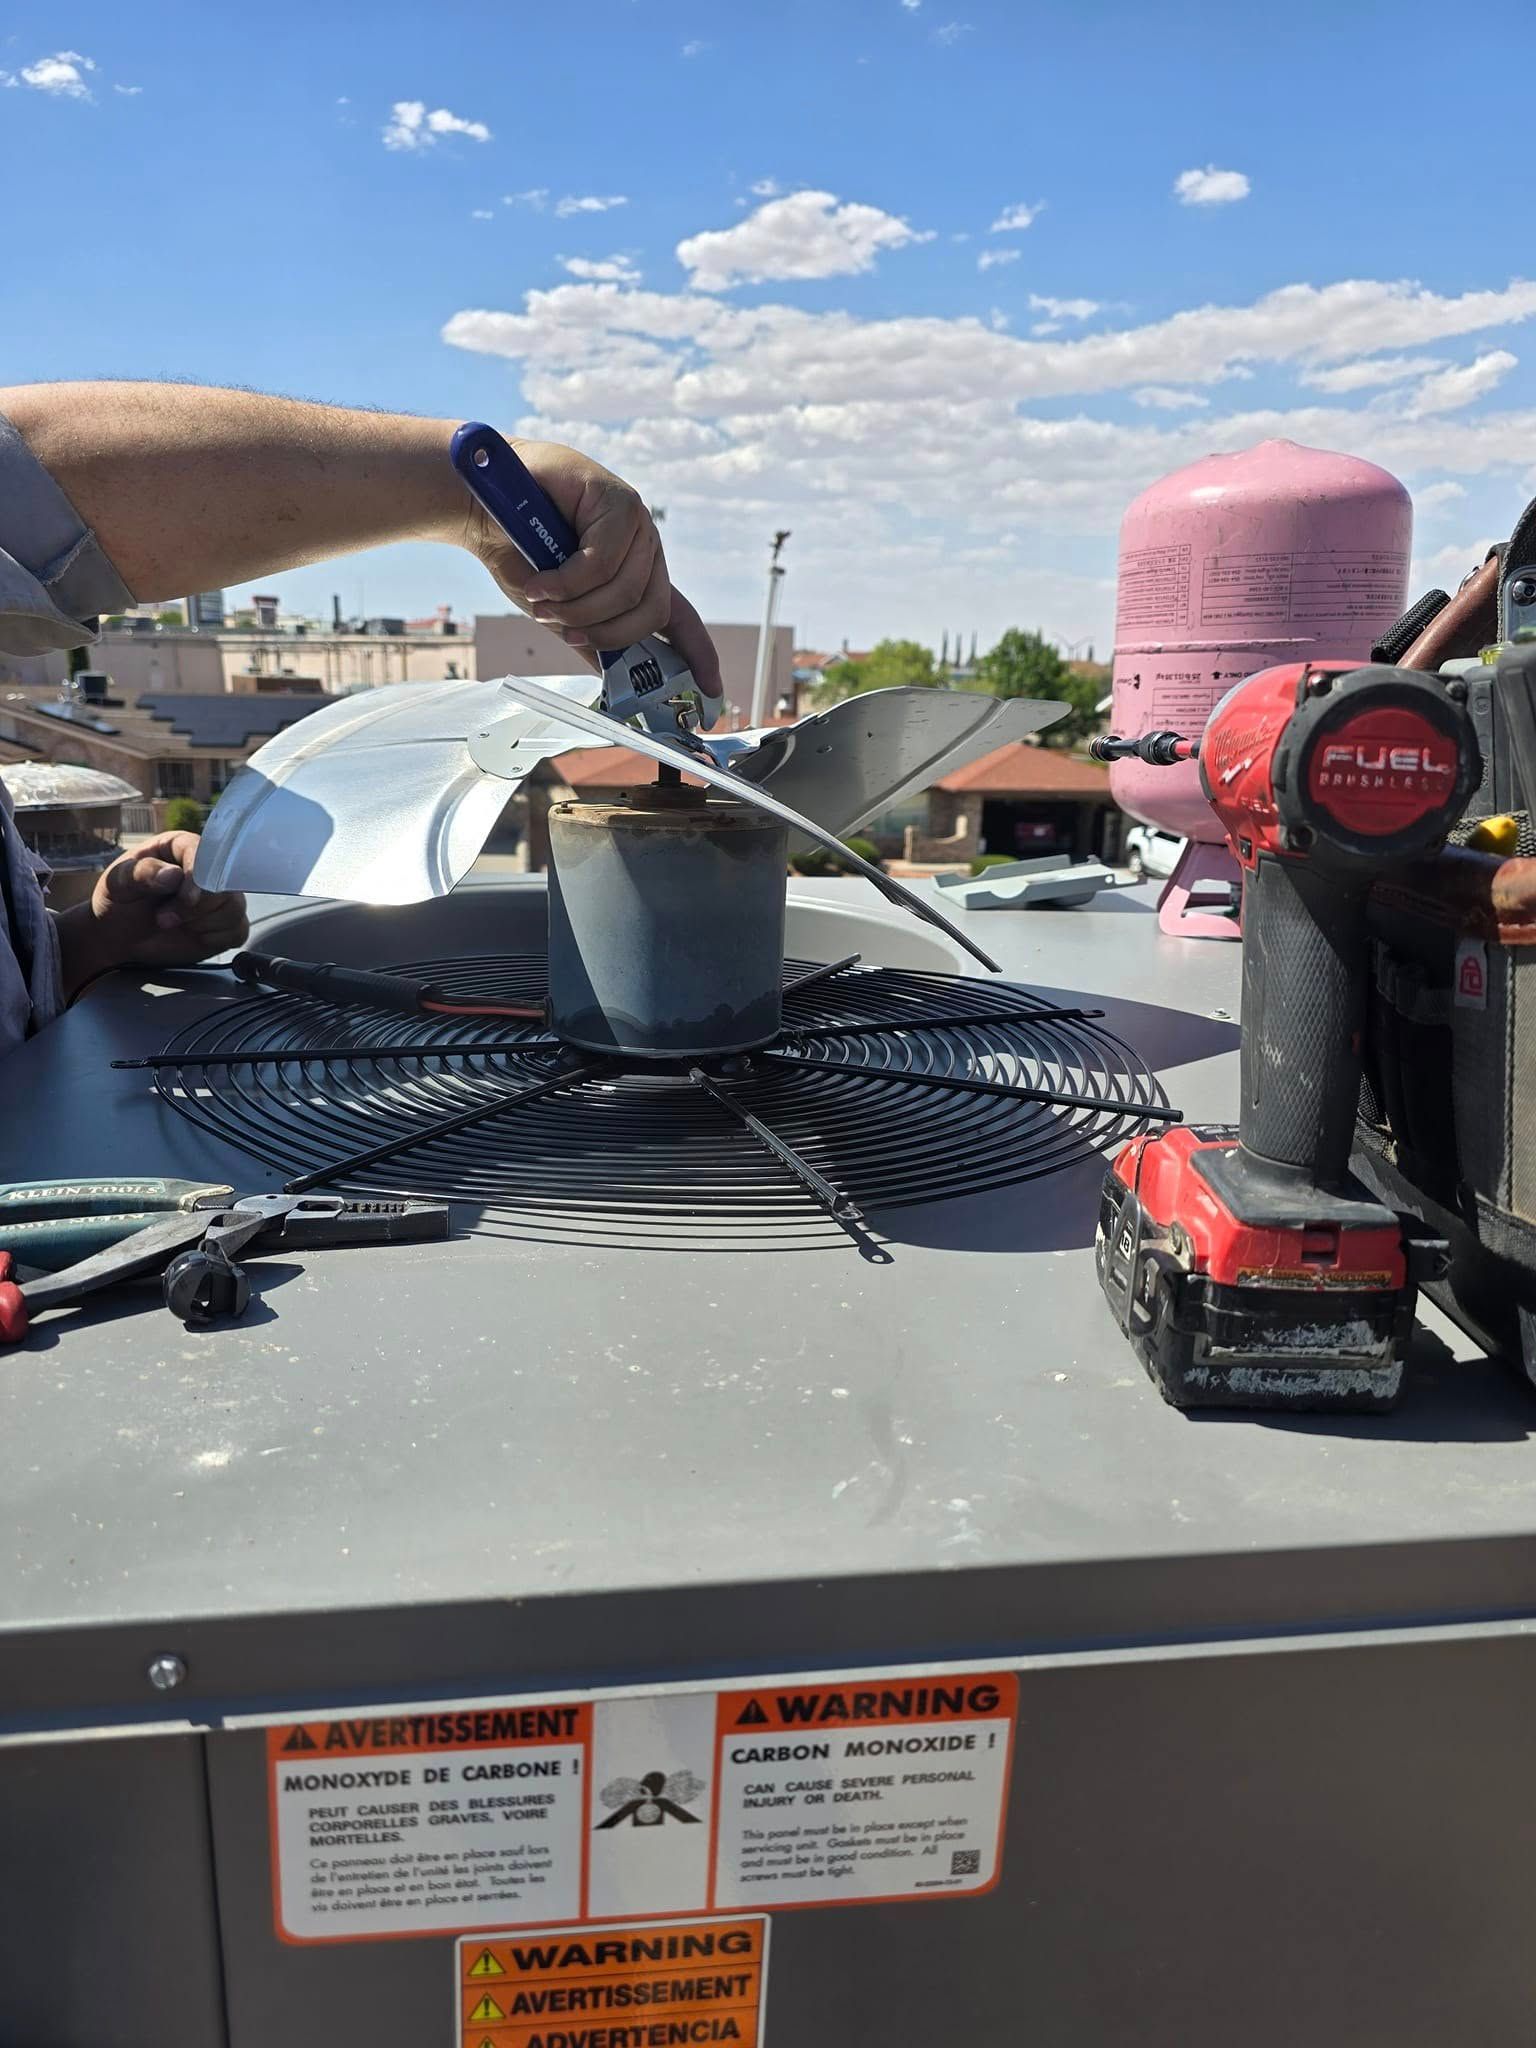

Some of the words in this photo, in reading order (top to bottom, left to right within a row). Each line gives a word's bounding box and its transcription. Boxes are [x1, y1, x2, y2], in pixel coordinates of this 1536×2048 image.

[528, 516, 559, 554] TOOLS
[1322, 744, 1450, 773] FUEL
[1319, 771, 1446, 792] BRUSHLES
[8, 1186, 81, 1201] KLEIN
[86, 1184, 161, 1195] TOOLS
[777, 1685, 1000, 1723] WARNING
[324, 1708, 579, 1750] AVERTISSEMENT
[731, 1744, 829, 1764] CARBON
[844, 1735, 976, 1757] MONOXIDE
[987, 1733, 995, 1749] !
[284, 1769, 411, 1792] MONOXYDE
[423, 1767, 450, 1783] DE
[462, 1761, 561, 1781] CARBONE
[573, 1758, 579, 1775] !
[743, 1783, 775, 1795] CAN
[785, 1779, 833, 1792] CAUSE
[841, 1776, 895, 1789] SEVERE
[902, 1770, 976, 1784] PERSONAL
[309, 1806, 348, 1819] PEUT
[357, 1802, 419, 1816] CAUSER
[429, 1800, 458, 1812] DES
[468, 1793, 555, 1809] BLESSURES
[743, 1796, 796, 1808] INJURY
[804, 1793, 824, 1804] OR
[833, 1790, 883, 1803] DEATH.
[309, 1816, 418, 1832] CORPORELLES
[428, 1811, 494, 1826] GRAVES,
[502, 1808, 547, 1820] VOIRE
[742, 1829, 765, 1839] This
[768, 1826, 800, 1840] panel
[803, 1826, 829, 1836] must
[832, 1824, 846, 1834] be
[850, 1823, 860, 1833] in
[864, 1821, 895, 1834] place
[898, 1819, 935, 1830] except
[938, 1816, 968, 1826] when
[310, 1831, 405, 1847] MORTELLES.
[875, 1835, 901, 1845] must
[903, 1833, 918, 1843] be
[921, 1832, 931, 1841] in
[935, 1829, 965, 1842] place
[332, 1857, 386, 1870] panneau
[463, 1848, 496, 1861] place
[741, 1857, 764, 1868] and
[795, 1855, 810, 1865] be
[813, 1854, 825, 1863] in
[827, 1850, 858, 1864] good
[860, 1847, 915, 1860] condition.
[922, 1844, 939, 1855] All
[310, 1872, 327, 1883] de
[393, 1867, 409, 1878] de
[508, 1859, 553, 1871] doivent
[810, 1867, 824, 1877] be
[357, 1883, 391, 1897] place
[425, 1894, 460, 1907] place
[511, 1930, 753, 1971] WARNING
[511, 1974, 753, 2016] AVERTISSEMENT
[526, 2017, 741, 2048] ADVERTENCIA
